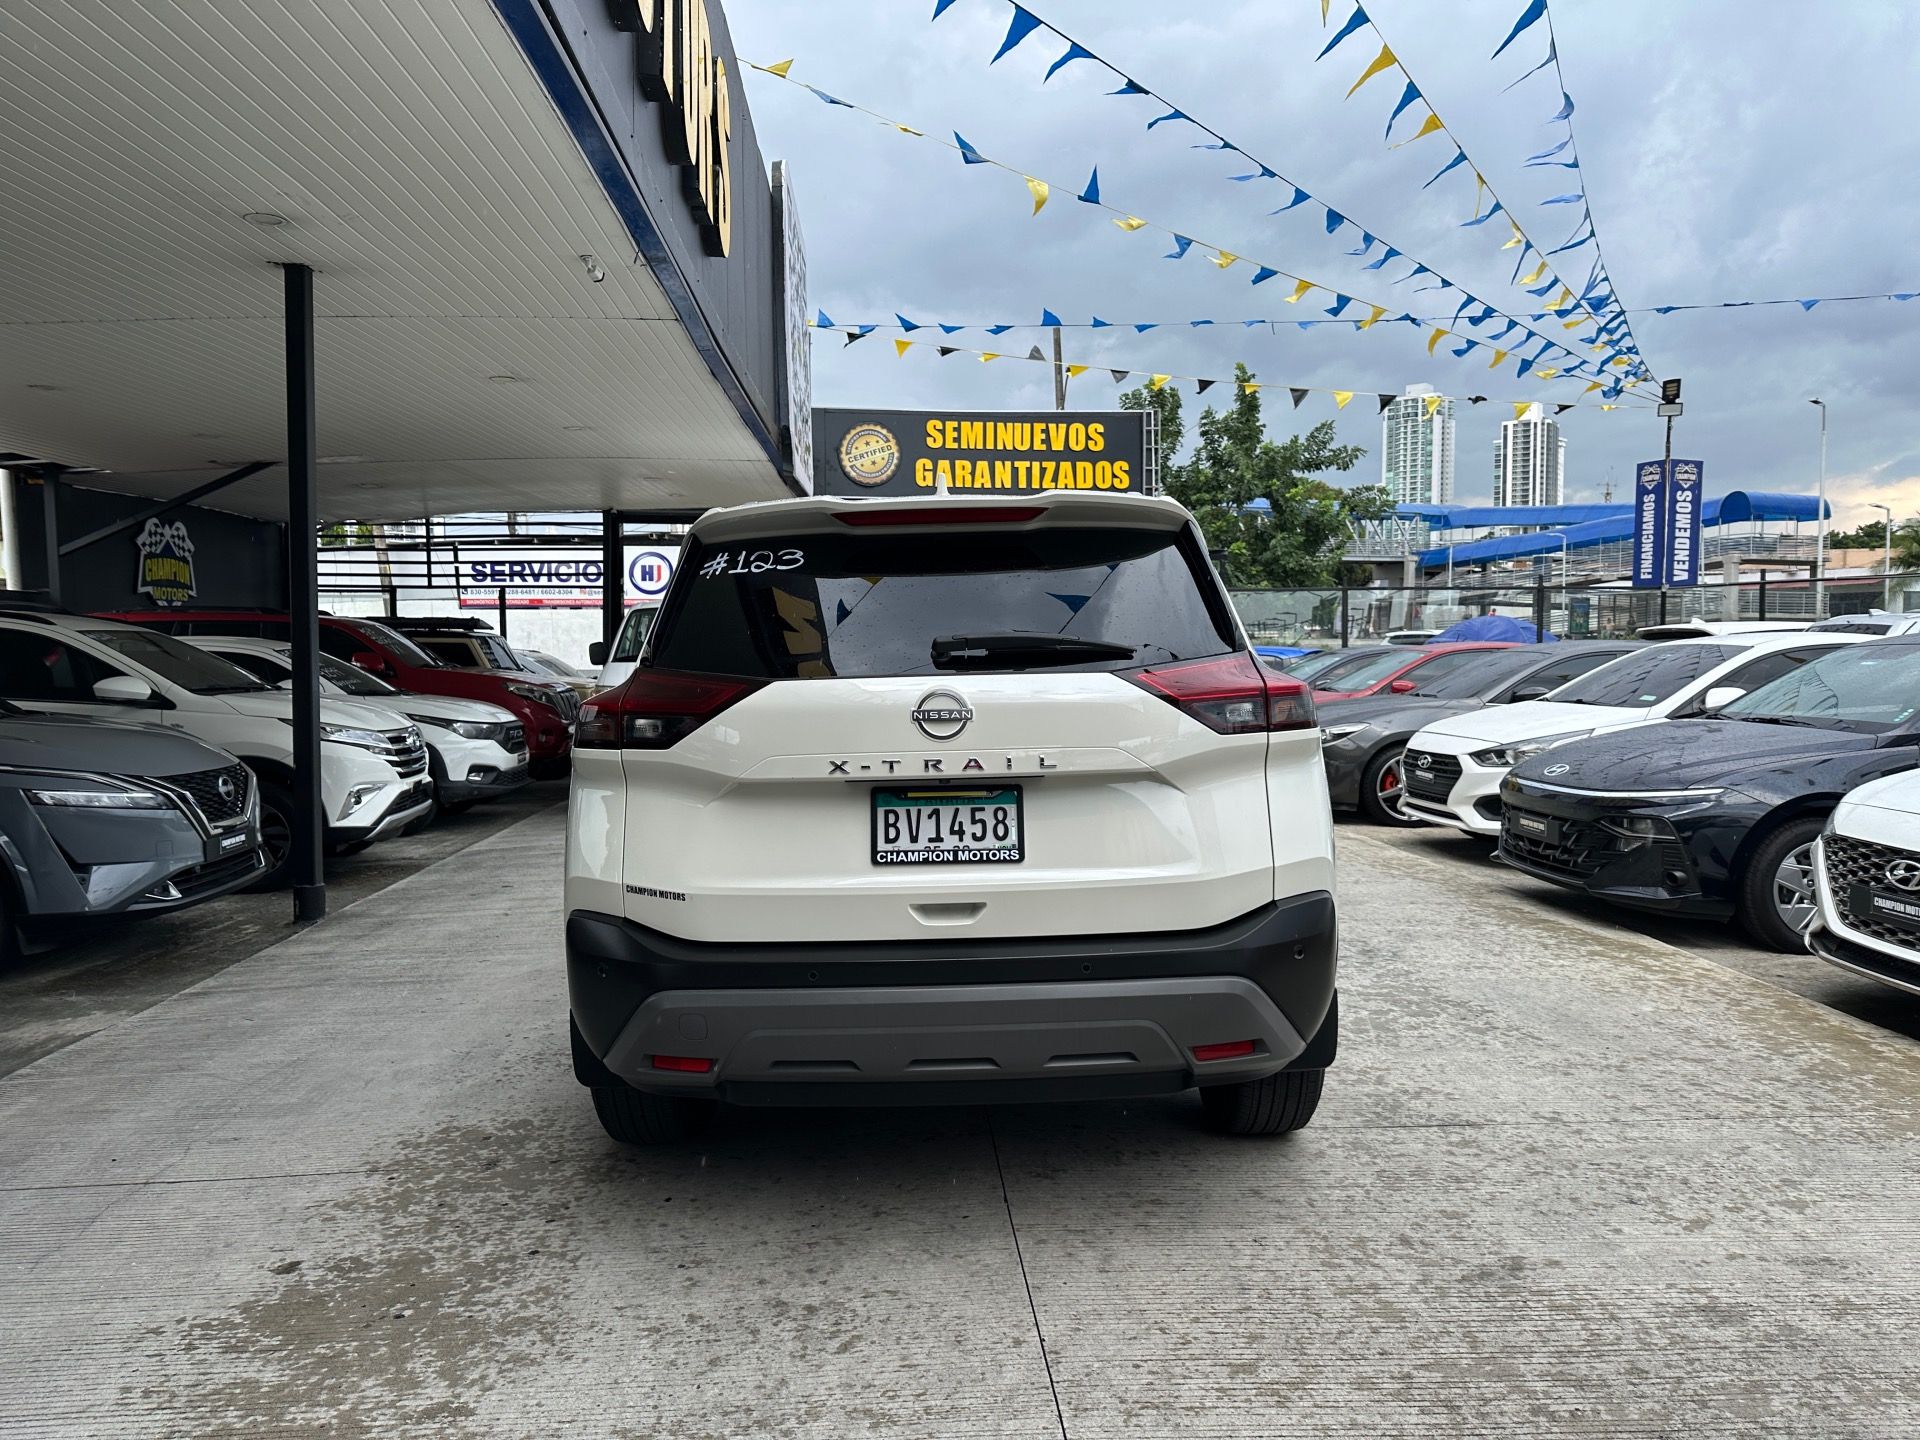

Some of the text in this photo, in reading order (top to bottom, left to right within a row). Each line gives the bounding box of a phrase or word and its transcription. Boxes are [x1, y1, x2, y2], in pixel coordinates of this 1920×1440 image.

[925, 419, 1105, 453] SEMINUEVOS
[848, 444, 893, 463] CERTIFIED
[915, 457, 1131, 490] GARANTIZADOS
[1640, 493, 1656, 580] FINANCIAMOS
[1672, 490, 1693, 582] VENDEMOS
[145, 557, 192, 586] CHAMPION
[471, 562, 602, 583] SERVICIO
[640, 564, 662, 583] HJ
[699, 549, 805, 580] #123
[152, 586, 189, 602] MOTORS
[913, 710, 972, 720] NISSAN
[828, 755, 1058, 775] X-TRAIL
[884, 806, 1009, 844] BV1458
[876, 849, 1020, 863] CHAMPION MOTORS
[625, 884, 686, 902] CHAMPION MOTORS
[1873, 896, 1905, 912] CHAMPION
